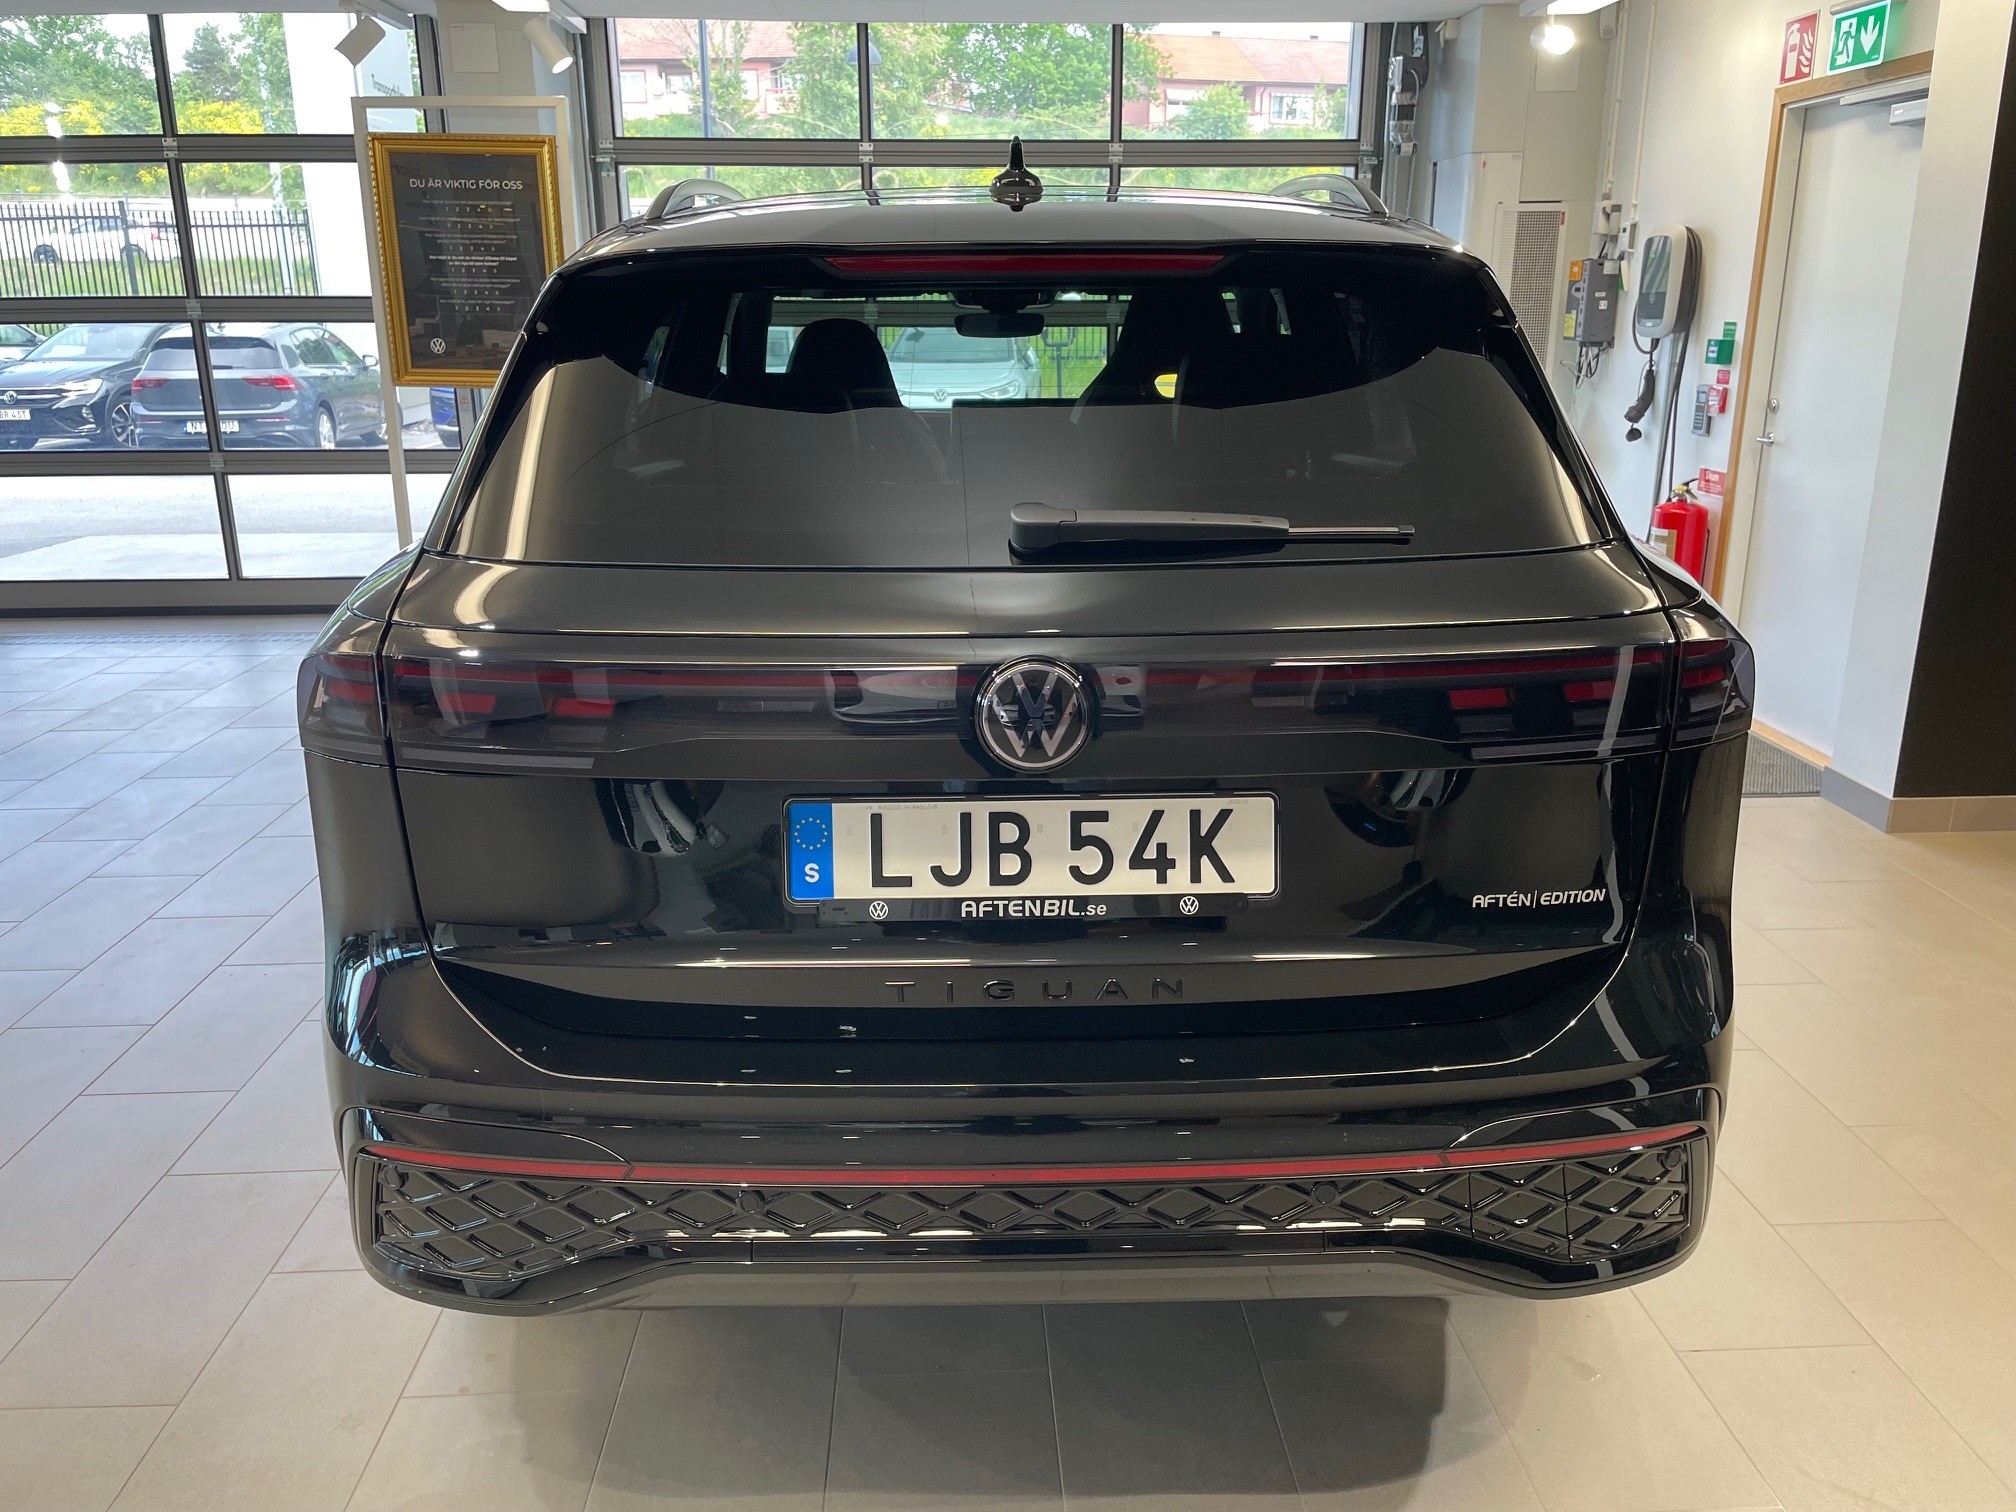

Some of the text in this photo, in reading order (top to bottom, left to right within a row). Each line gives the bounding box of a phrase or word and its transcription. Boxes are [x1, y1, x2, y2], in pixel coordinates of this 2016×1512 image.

[409, 178, 523, 190] DU ÄR VIKTIG FÖR OSS
[870, 808, 1236, 888] LJB 54K
[804, 862, 820, 883] S
[961, 899, 1107, 918] AFTENBIL.se
[884, 978, 1183, 1003] TIGUAN
